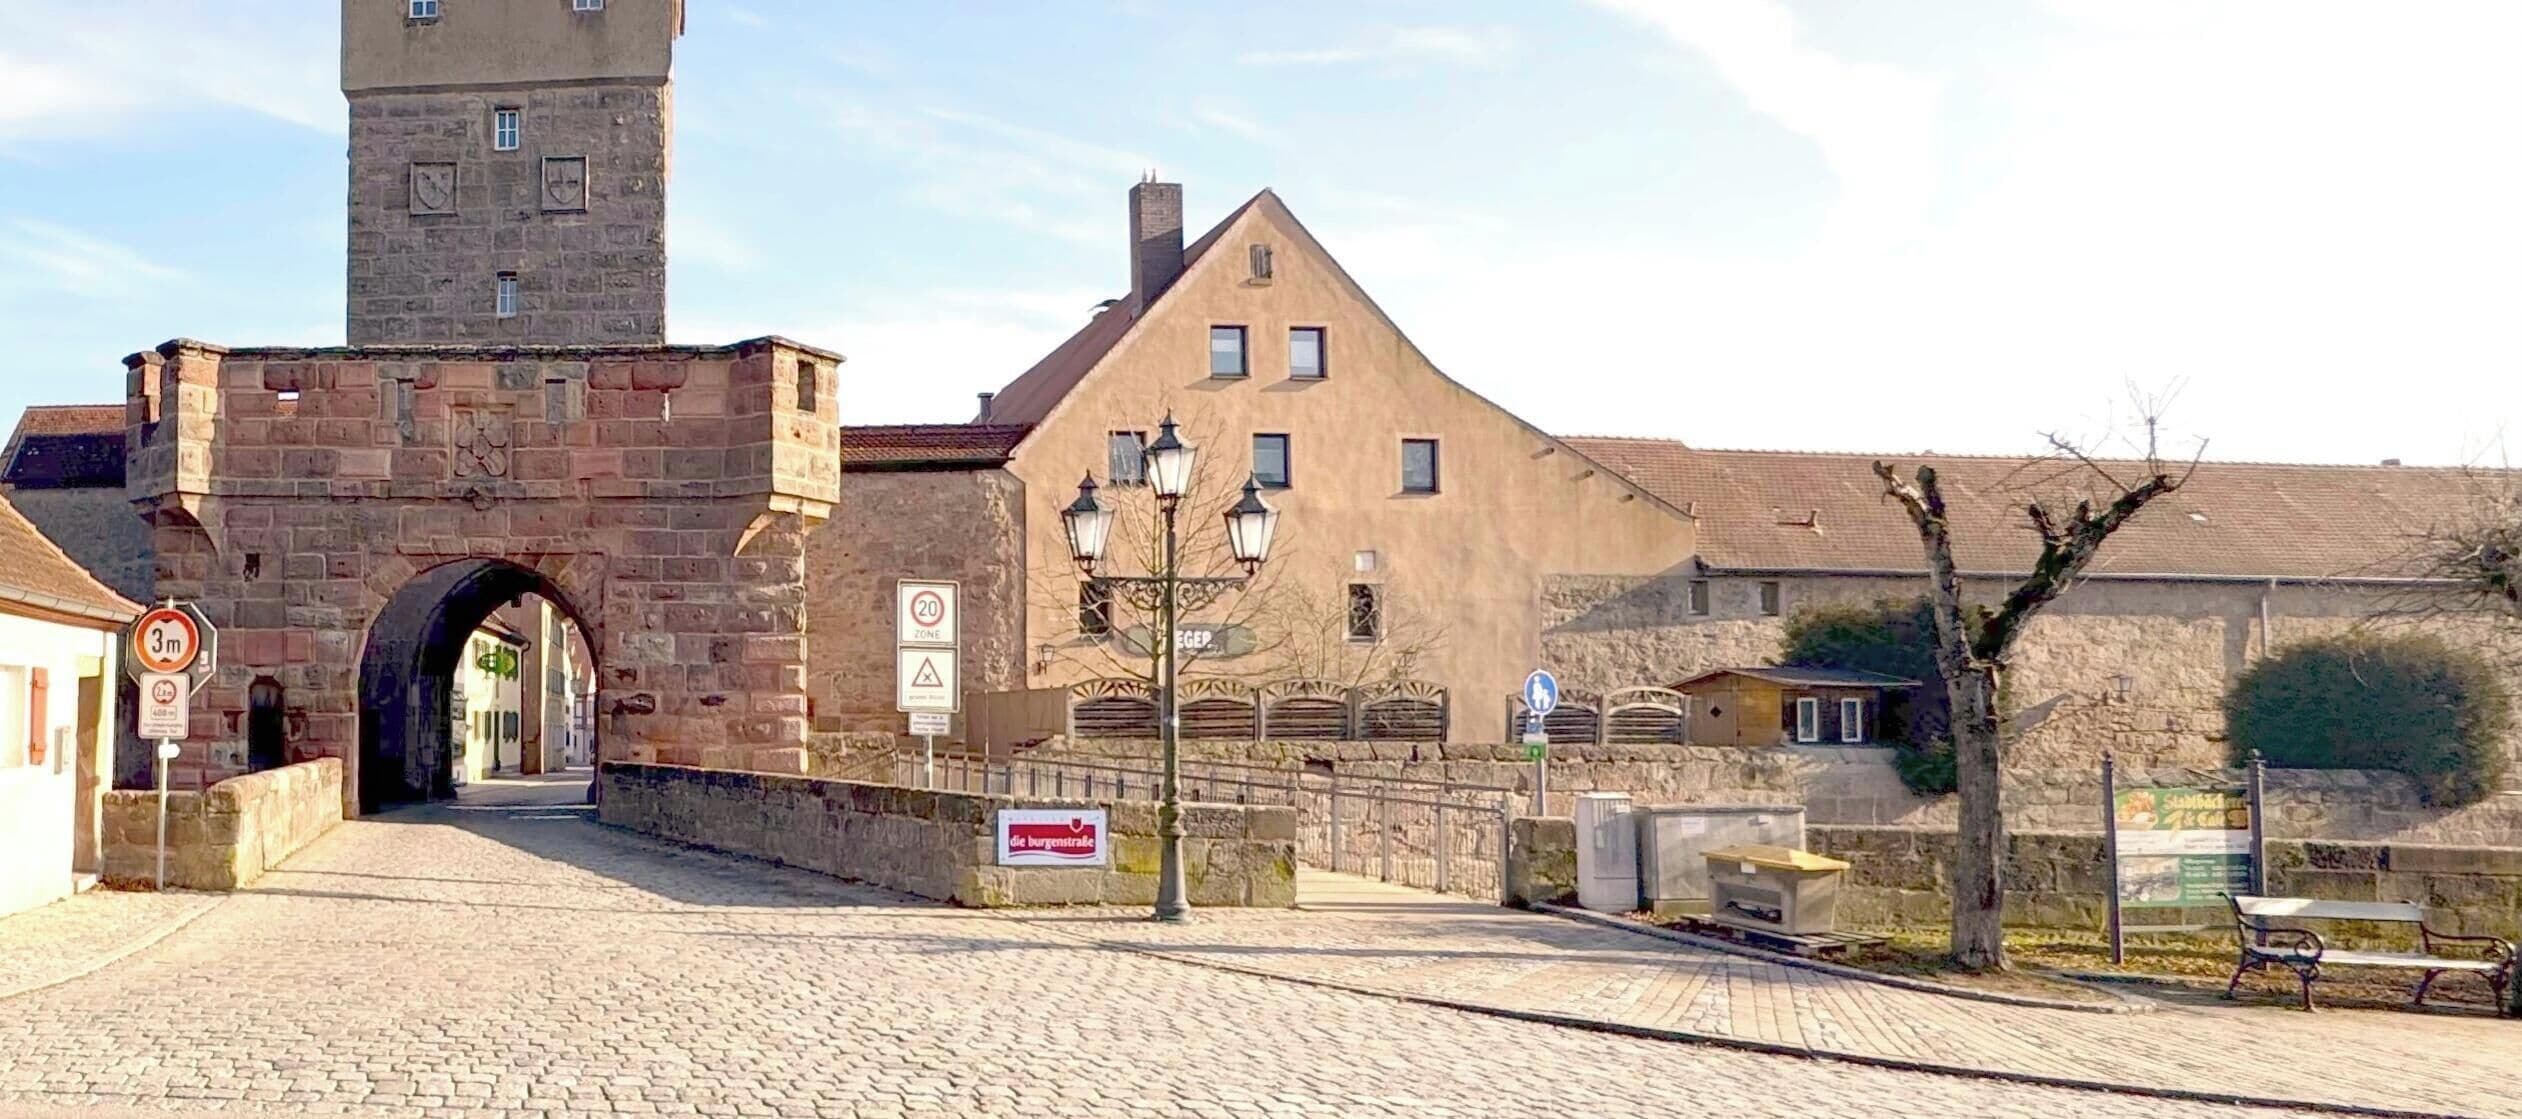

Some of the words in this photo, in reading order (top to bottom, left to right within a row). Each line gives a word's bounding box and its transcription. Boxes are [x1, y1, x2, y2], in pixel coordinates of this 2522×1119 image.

[918, 600, 938, 617] 20
[151, 628, 163, 653] 3
[167, 638, 181, 653] m
[914, 629, 941, 639] ZONE
[1010, 835, 1026, 847] die
[1028, 835, 1094, 850] burgenstraße
